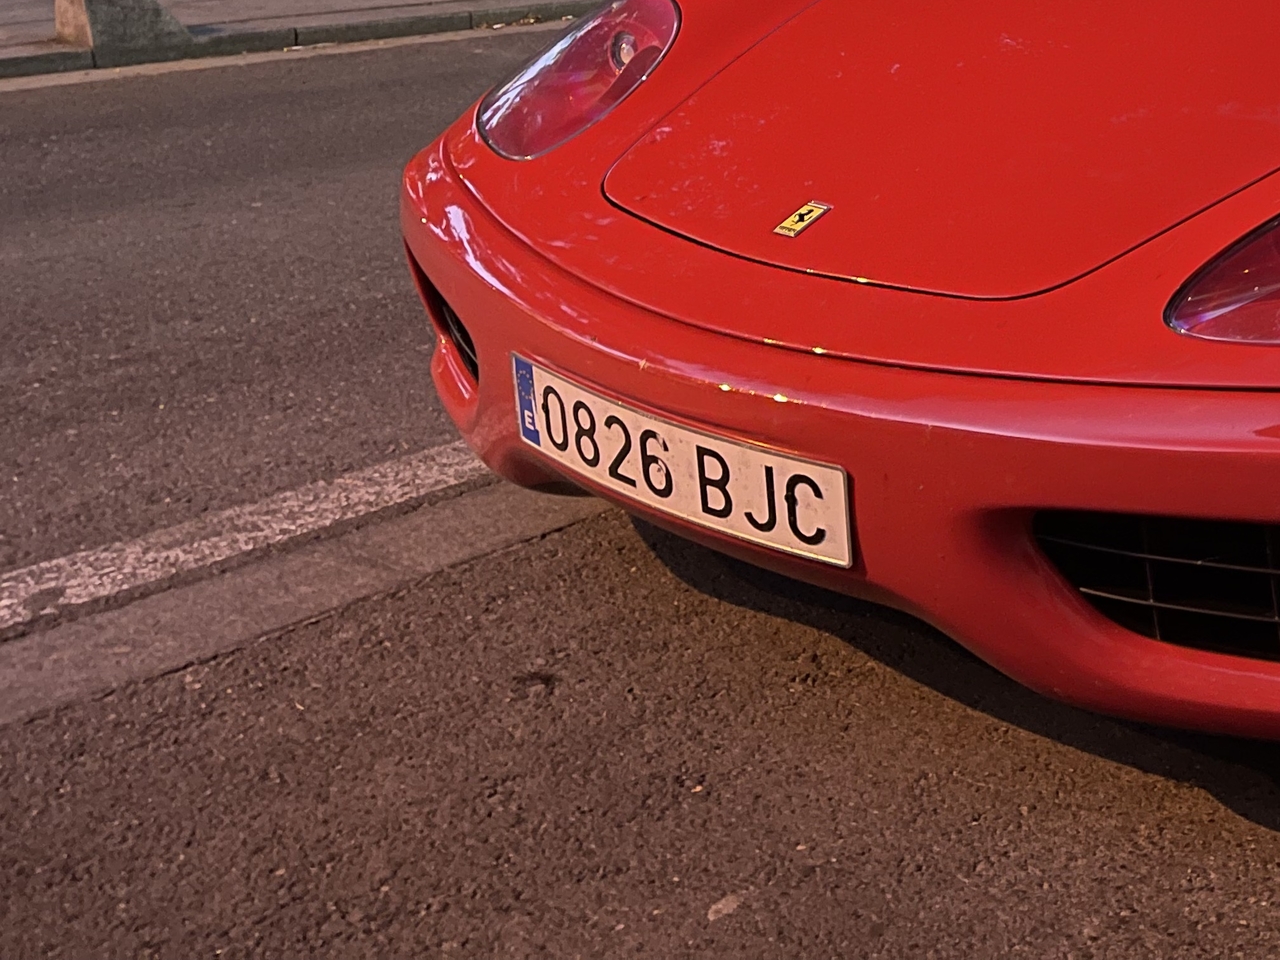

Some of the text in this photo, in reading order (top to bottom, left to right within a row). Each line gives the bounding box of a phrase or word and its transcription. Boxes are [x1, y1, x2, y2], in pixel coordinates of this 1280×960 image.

[523, 409, 535, 430] E
[541, 385, 826, 546] 0826 BJC
